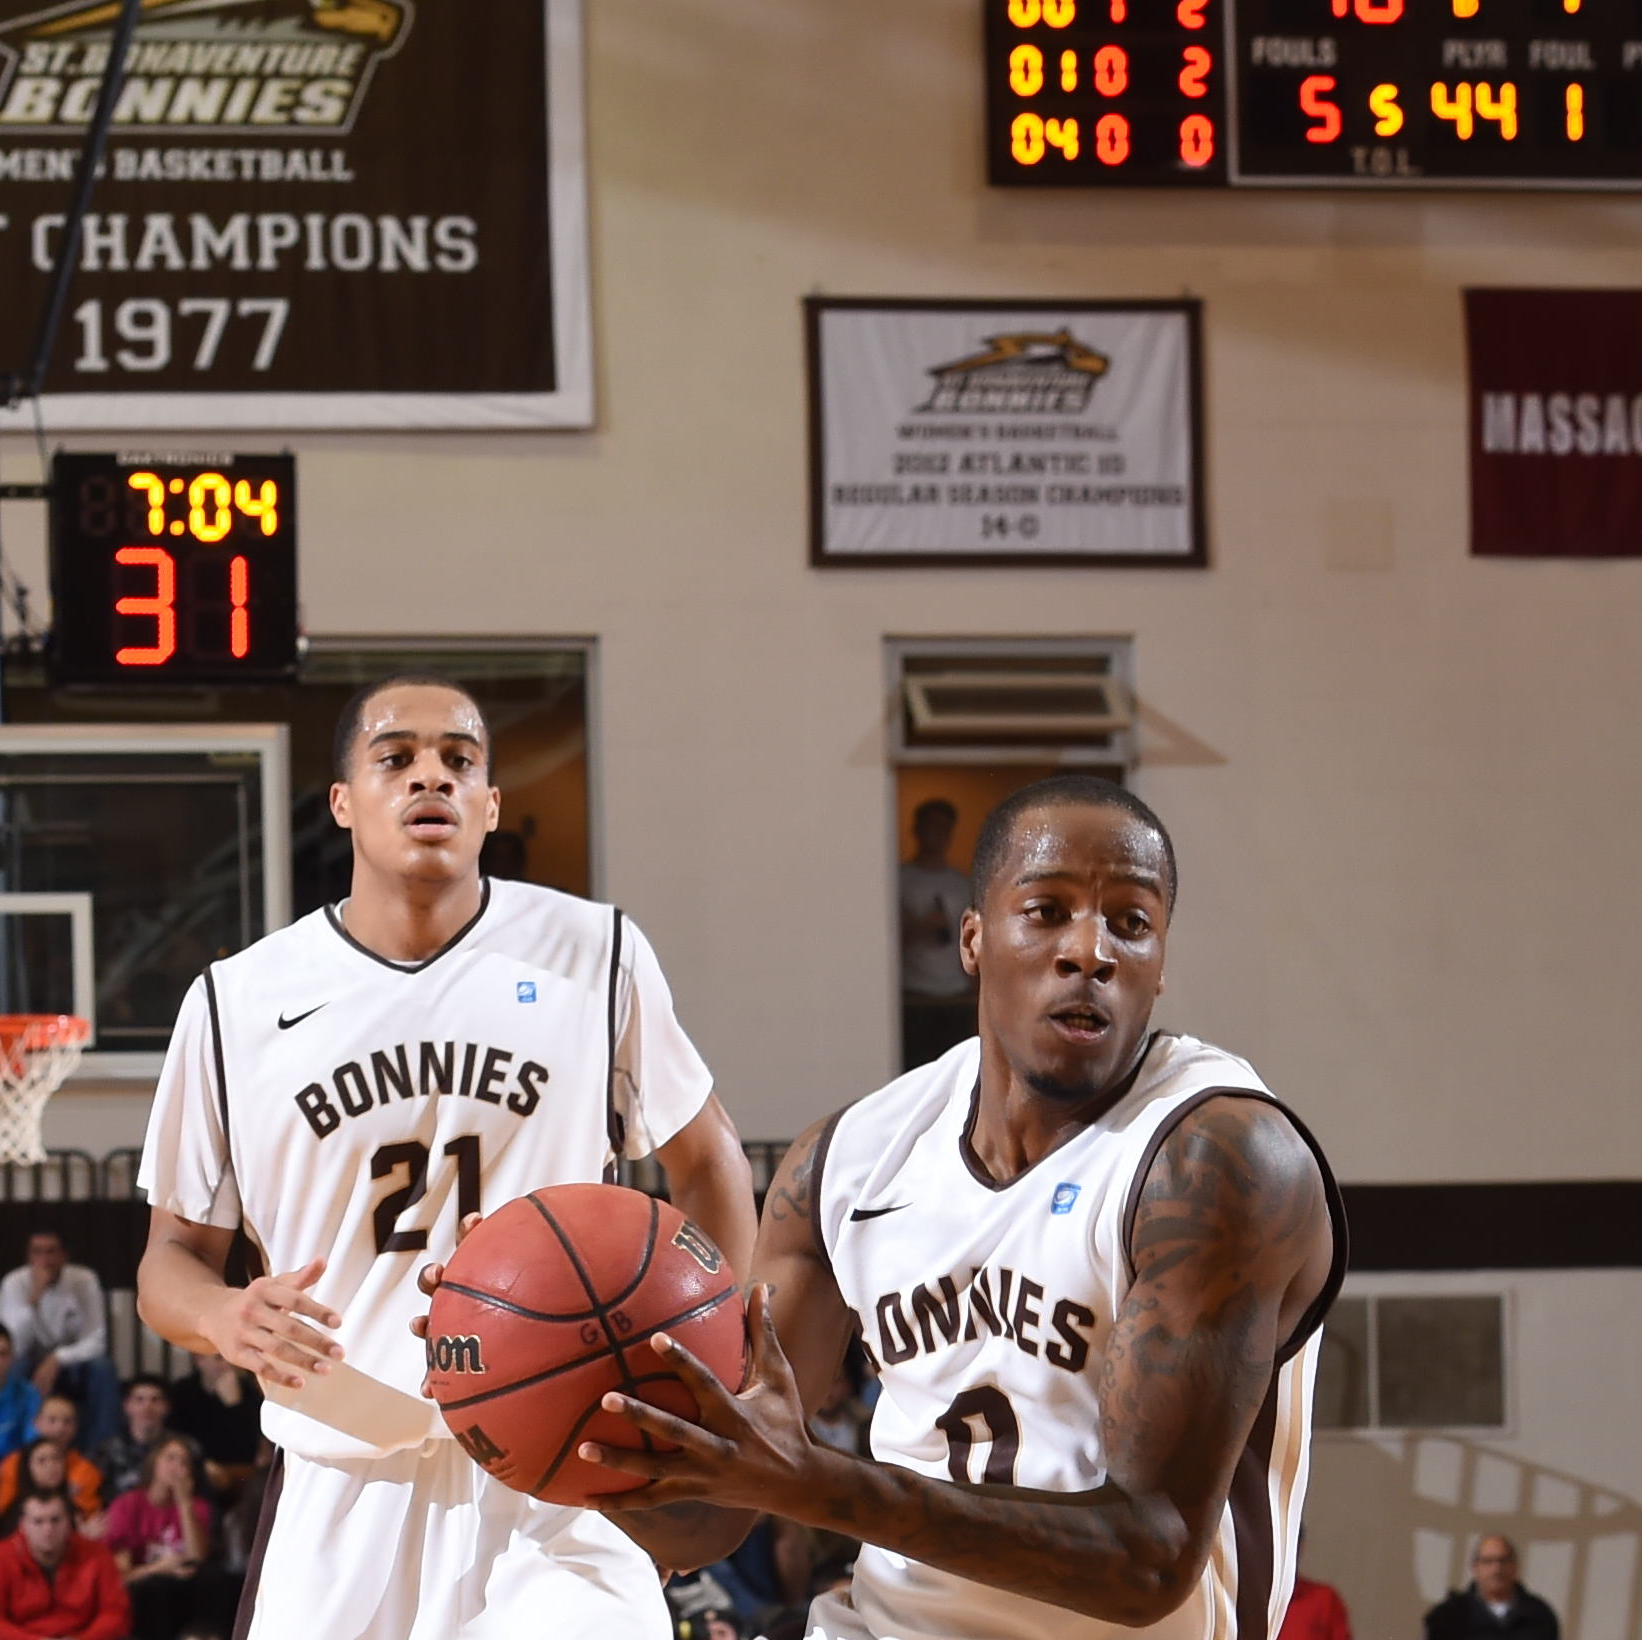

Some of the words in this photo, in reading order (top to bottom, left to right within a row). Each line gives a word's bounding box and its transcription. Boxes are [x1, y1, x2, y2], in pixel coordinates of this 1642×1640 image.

[1009, 44, 1077, 97] 01
[1094, 44, 1127, 97] 0
[1179, 46, 1211, 98] 2
[1251, 36, 1337, 68] FOULS
[1011, 112, 1079, 165] 04
[1096, 113, 1129, 165] 0
[1180, 114, 1212, 167] 0
[1300, 75, 1341, 142] 5
[1369, 83, 1403, 136] 5
[1430, 81, 1518, 140] 44
[1566, 83, 1583, 141] 1
[113, 149, 354, 181] BASKETBALL
[31, 213, 479, 273] CHAMPIONS
[73, 298, 290, 373] 1977
[958, 452, 1090, 475] ATLANTIC
[128, 472, 278, 542] 7:04
[115, 547, 248, 665] 31
[294, 1040, 549, 1140] BONNIES
[370, 1133, 484, 1256] 21
